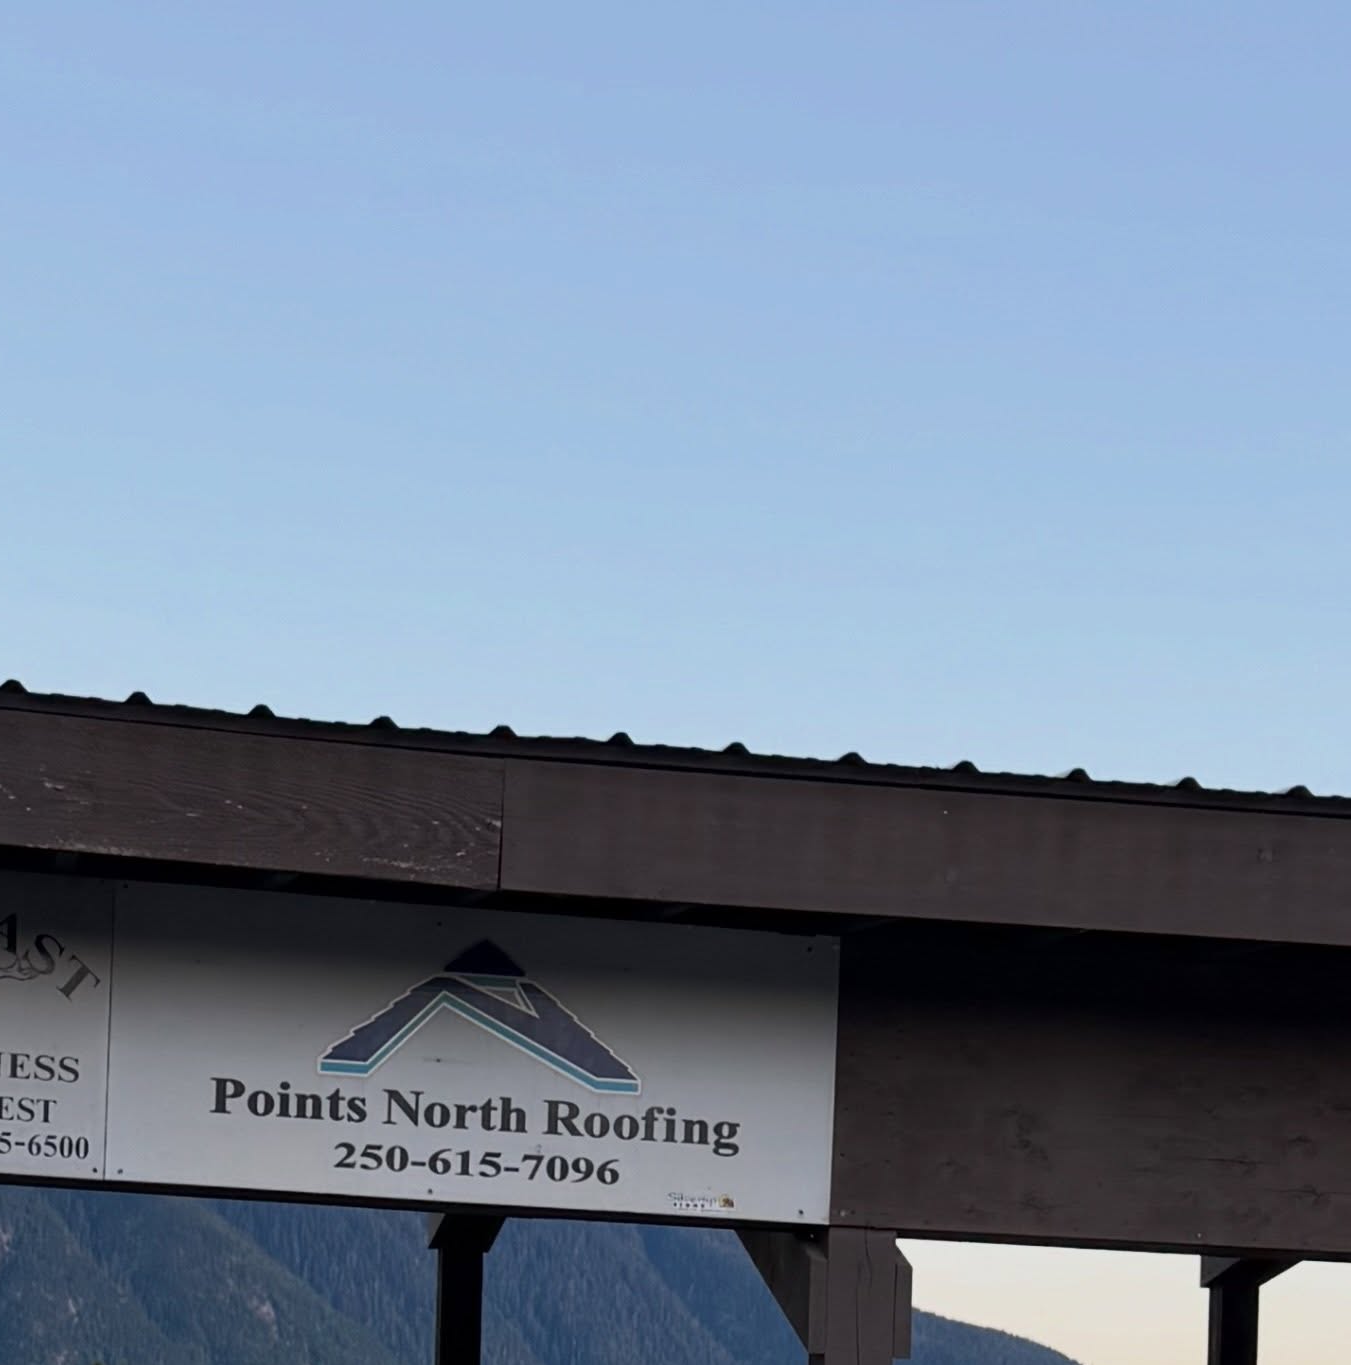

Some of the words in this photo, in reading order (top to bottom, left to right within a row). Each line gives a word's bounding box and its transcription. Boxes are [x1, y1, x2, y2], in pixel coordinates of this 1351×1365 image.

[209, 1076, 368, 1124] Points
[383, 1088, 528, 1135] North
[543, 1097, 742, 1158] Roofing
[332, 1141, 621, 1187] 250-615-7096
